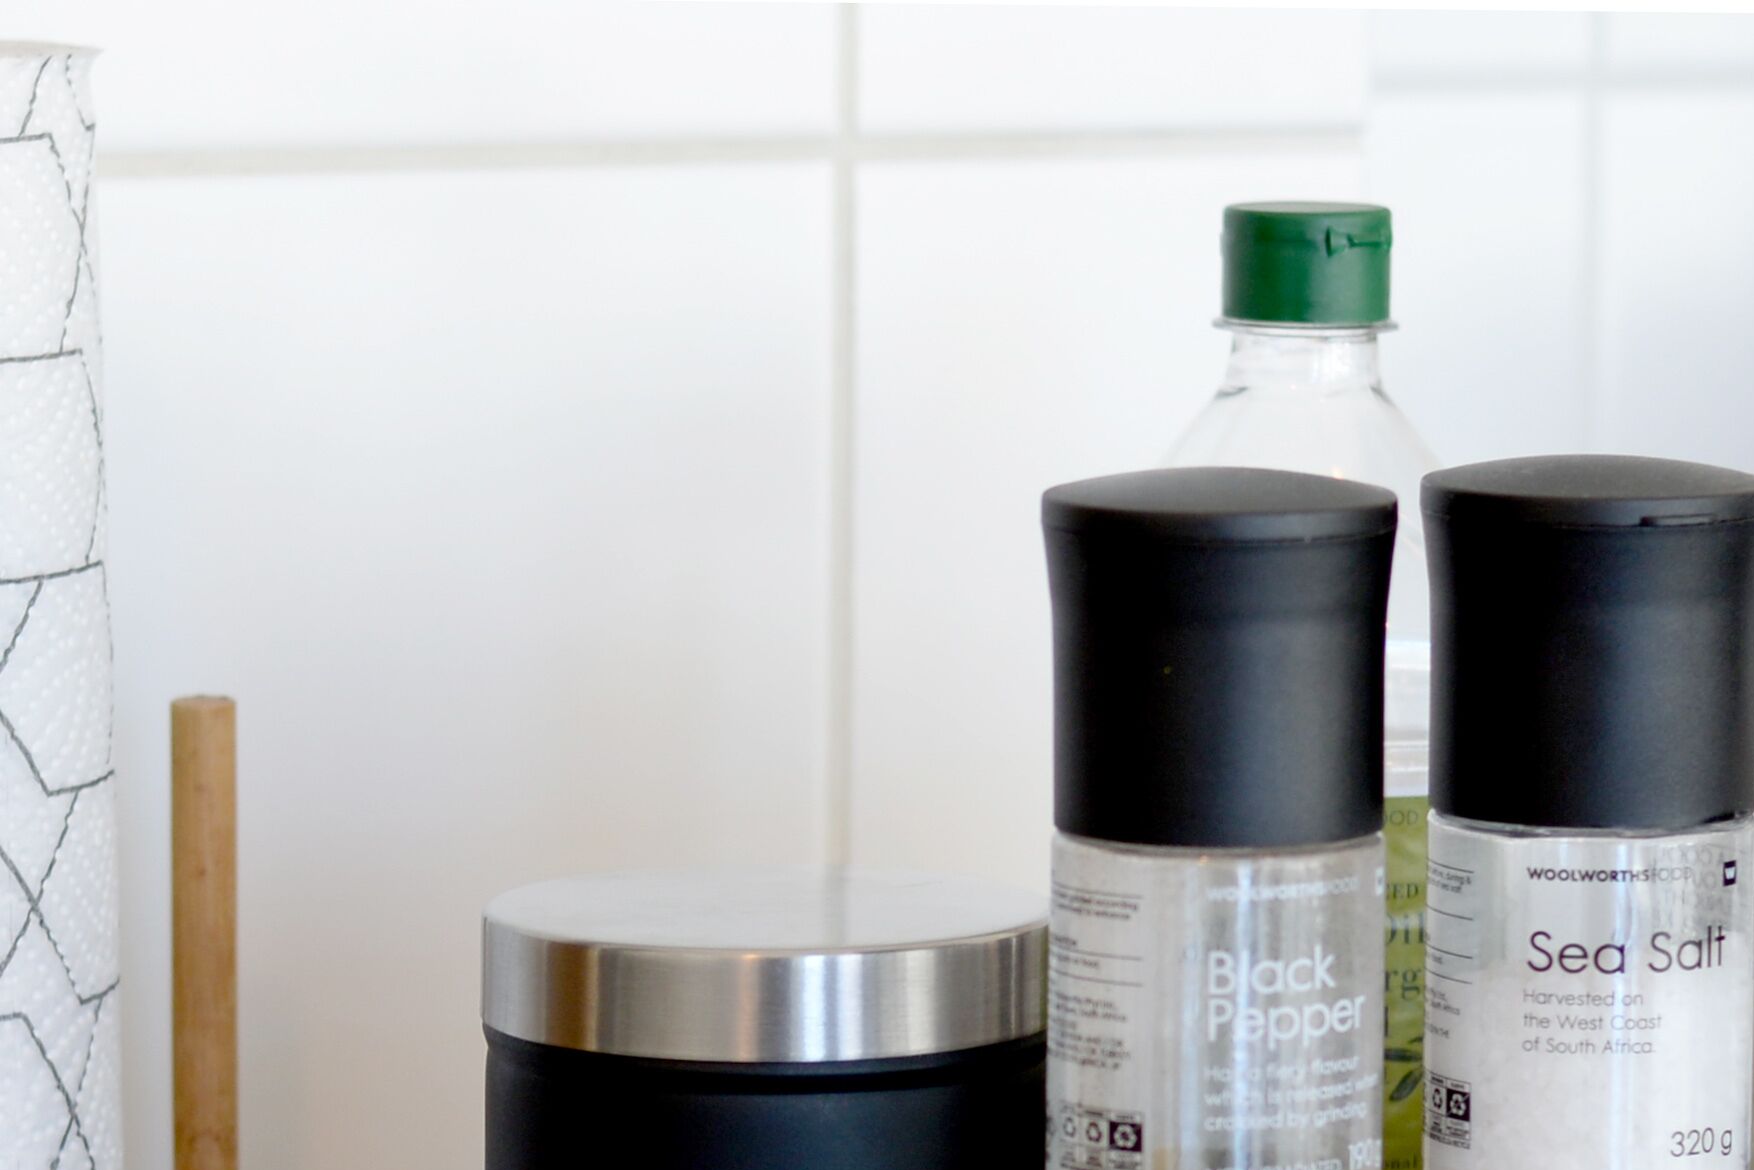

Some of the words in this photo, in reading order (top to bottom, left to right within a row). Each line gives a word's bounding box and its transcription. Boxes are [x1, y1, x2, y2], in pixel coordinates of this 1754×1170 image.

[1527, 931, 1625, 974] Sea
[1649, 925, 1727, 974] Salt
[1207, 943, 1336, 995] Black
[1522, 988, 1615, 1007] Harvested
[1622, 993, 1644, 1007] on
[1207, 995, 1366, 1050] Pepper
[1523, 1012, 1550, 1029] the
[1556, 1014, 1604, 1031] West
[1610, 1013, 1662, 1031] Coast
[1521, 1036, 1540, 1052] of
[1545, 1037, 1596, 1054] South
[1670, 1128, 1714, 1158] 320
[1720, 1128, 1733, 1156] g
